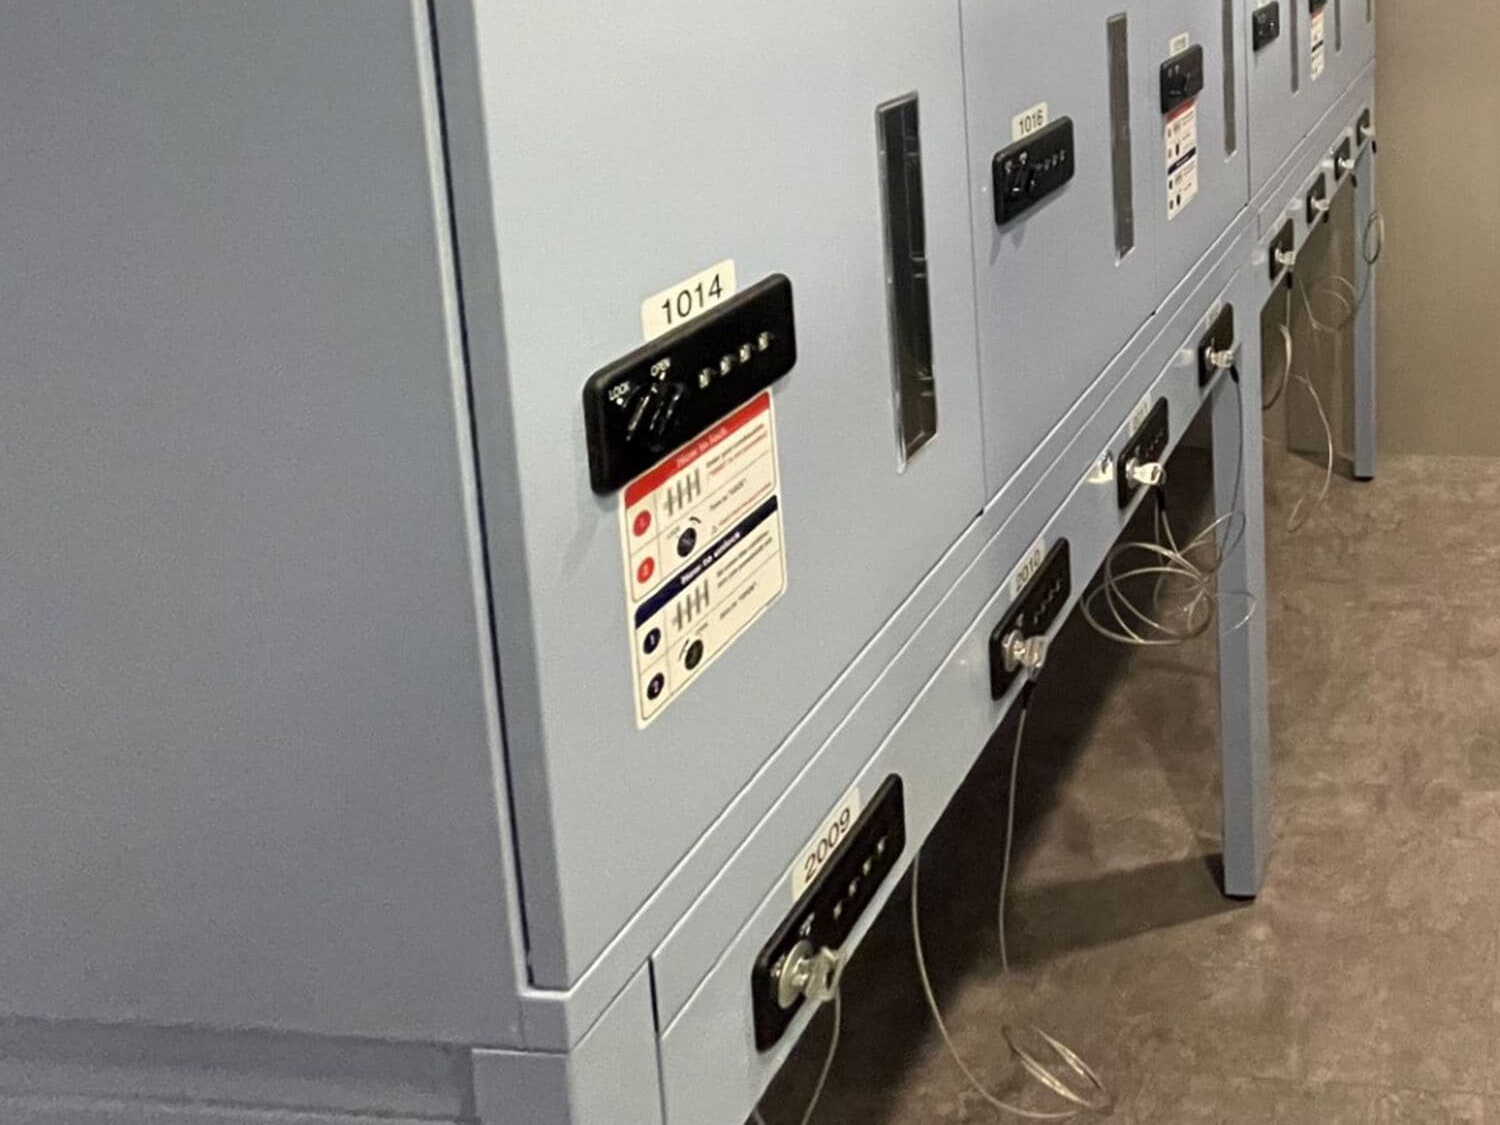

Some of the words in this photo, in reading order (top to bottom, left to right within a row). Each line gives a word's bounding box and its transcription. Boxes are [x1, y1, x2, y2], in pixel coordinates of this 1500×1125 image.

[1019, 109, 1043, 135] 1016
[661, 274, 723, 324] 1014
[804, 808, 850, 882] 2009
